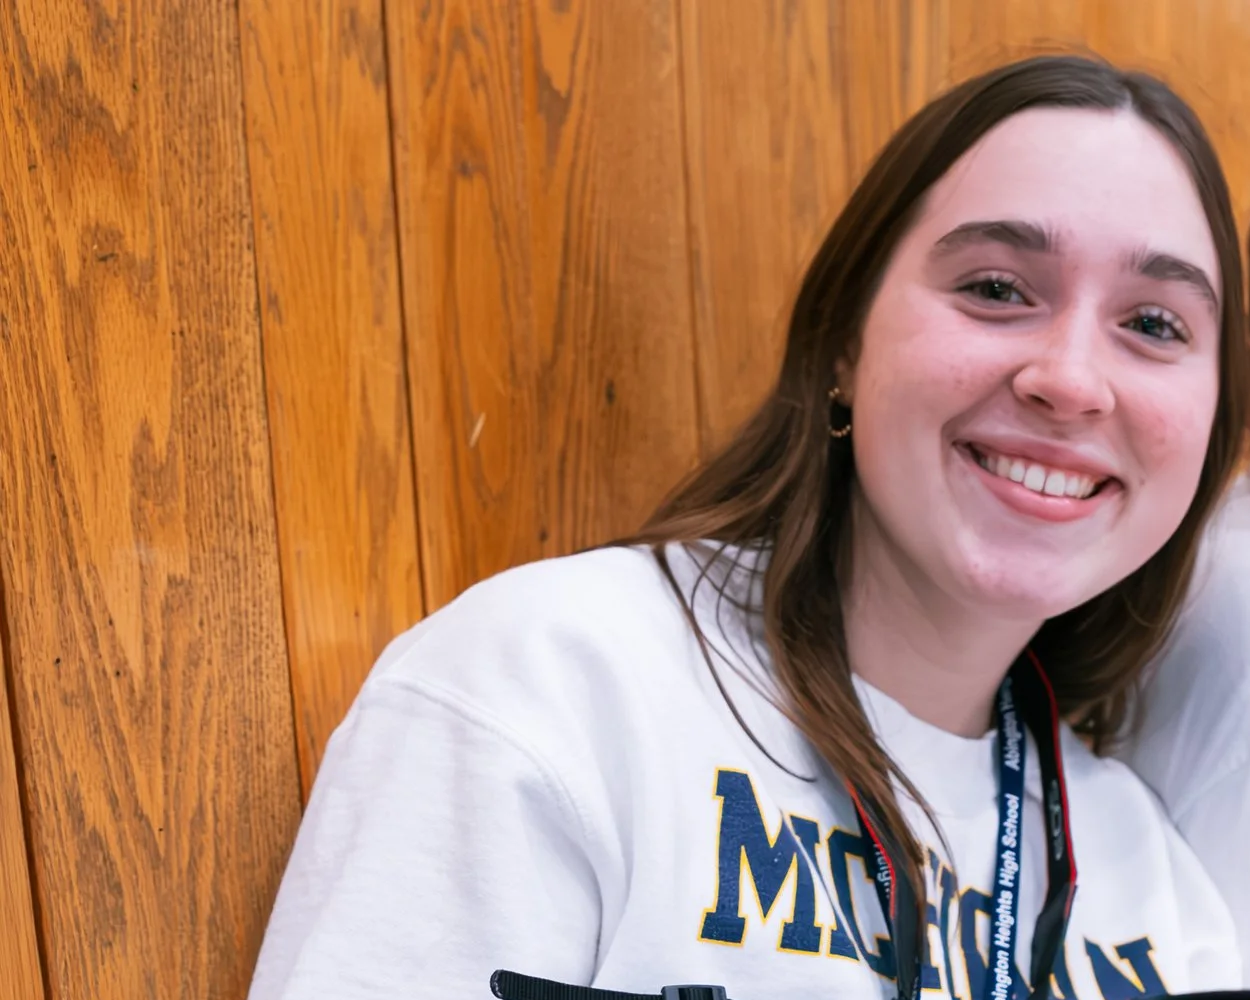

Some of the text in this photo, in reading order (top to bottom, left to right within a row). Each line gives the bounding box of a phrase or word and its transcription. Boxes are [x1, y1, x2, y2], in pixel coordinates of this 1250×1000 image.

[1001, 792, 1020, 850] School
[998, 850, 1019, 888] High
[994, 890, 1015, 949] Heights
